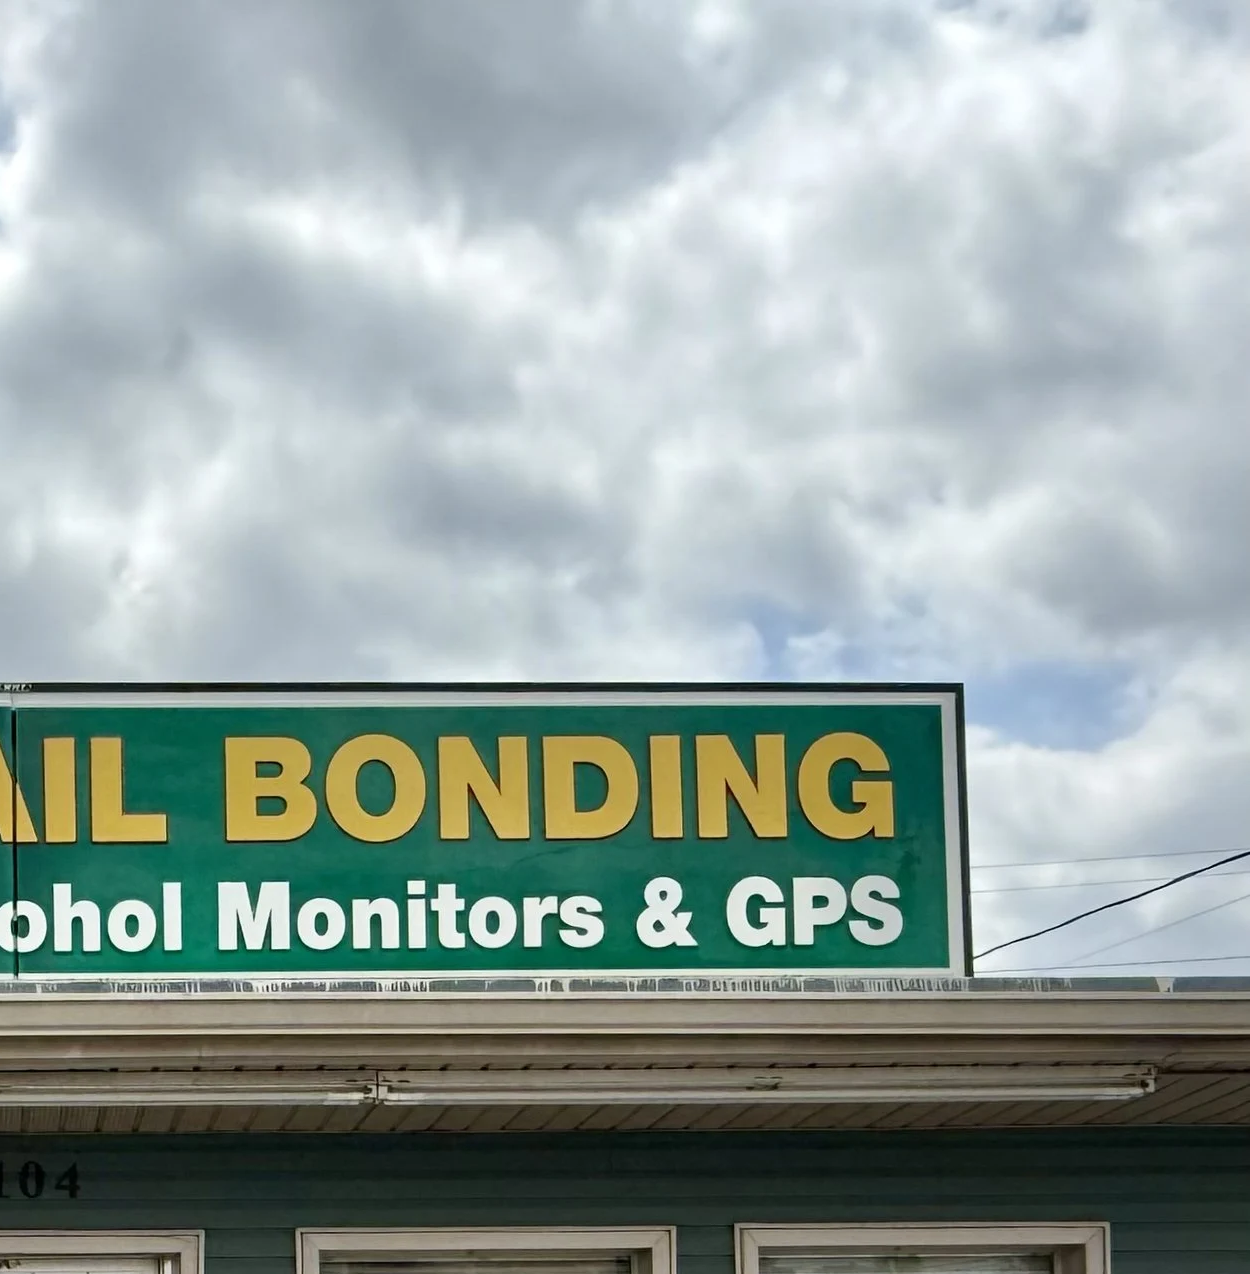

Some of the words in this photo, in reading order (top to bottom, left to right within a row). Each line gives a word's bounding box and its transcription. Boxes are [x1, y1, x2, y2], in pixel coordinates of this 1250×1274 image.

[223, 732, 895, 844] BONDING
[217, 880, 605, 951] Monitors
[635, 876, 698, 948] &
[726, 875, 904, 947] GPS
